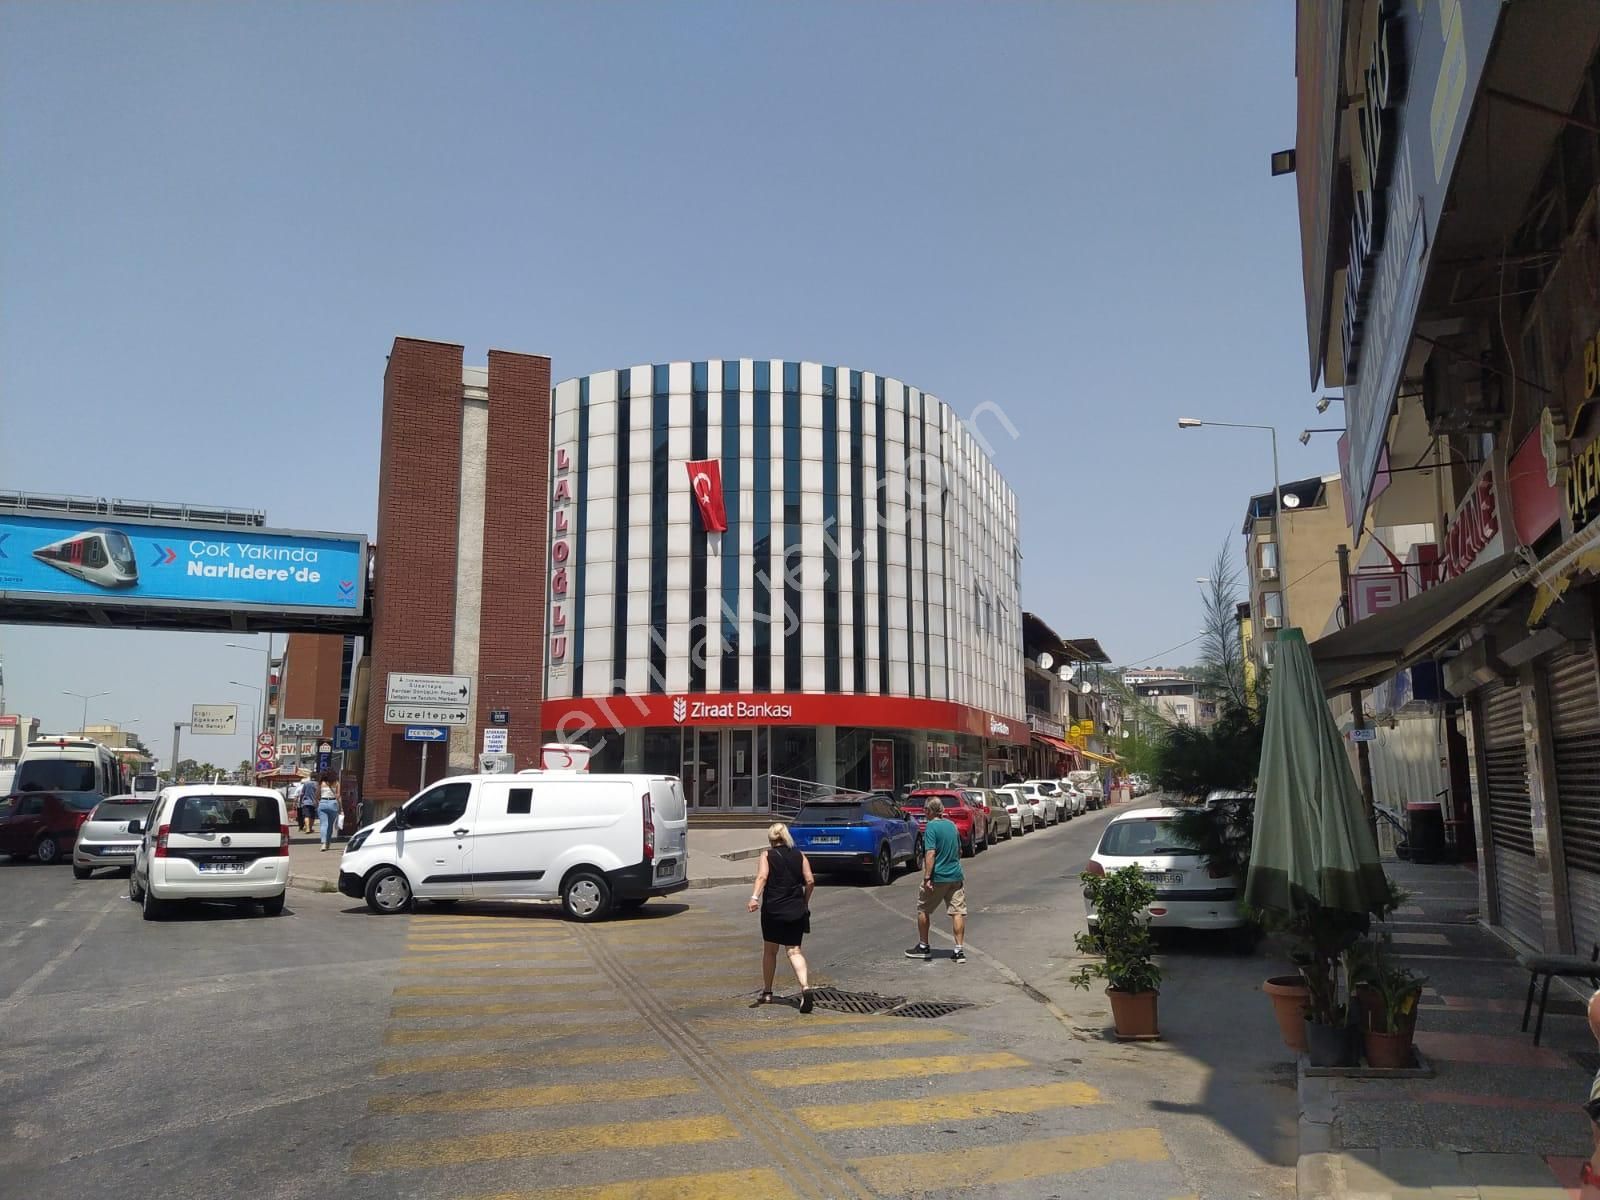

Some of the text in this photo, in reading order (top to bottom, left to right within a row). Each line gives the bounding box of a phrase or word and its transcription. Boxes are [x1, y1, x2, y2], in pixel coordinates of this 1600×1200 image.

[189, 540, 318, 563] Çok Yakında
[550, 448, 571, 660] LALOĞLU
[187, 560, 321, 583] Narlıdere’de
[388, 709, 455, 721] Güzeltepe
[690, 701, 793, 718] Ziraat Bankası
